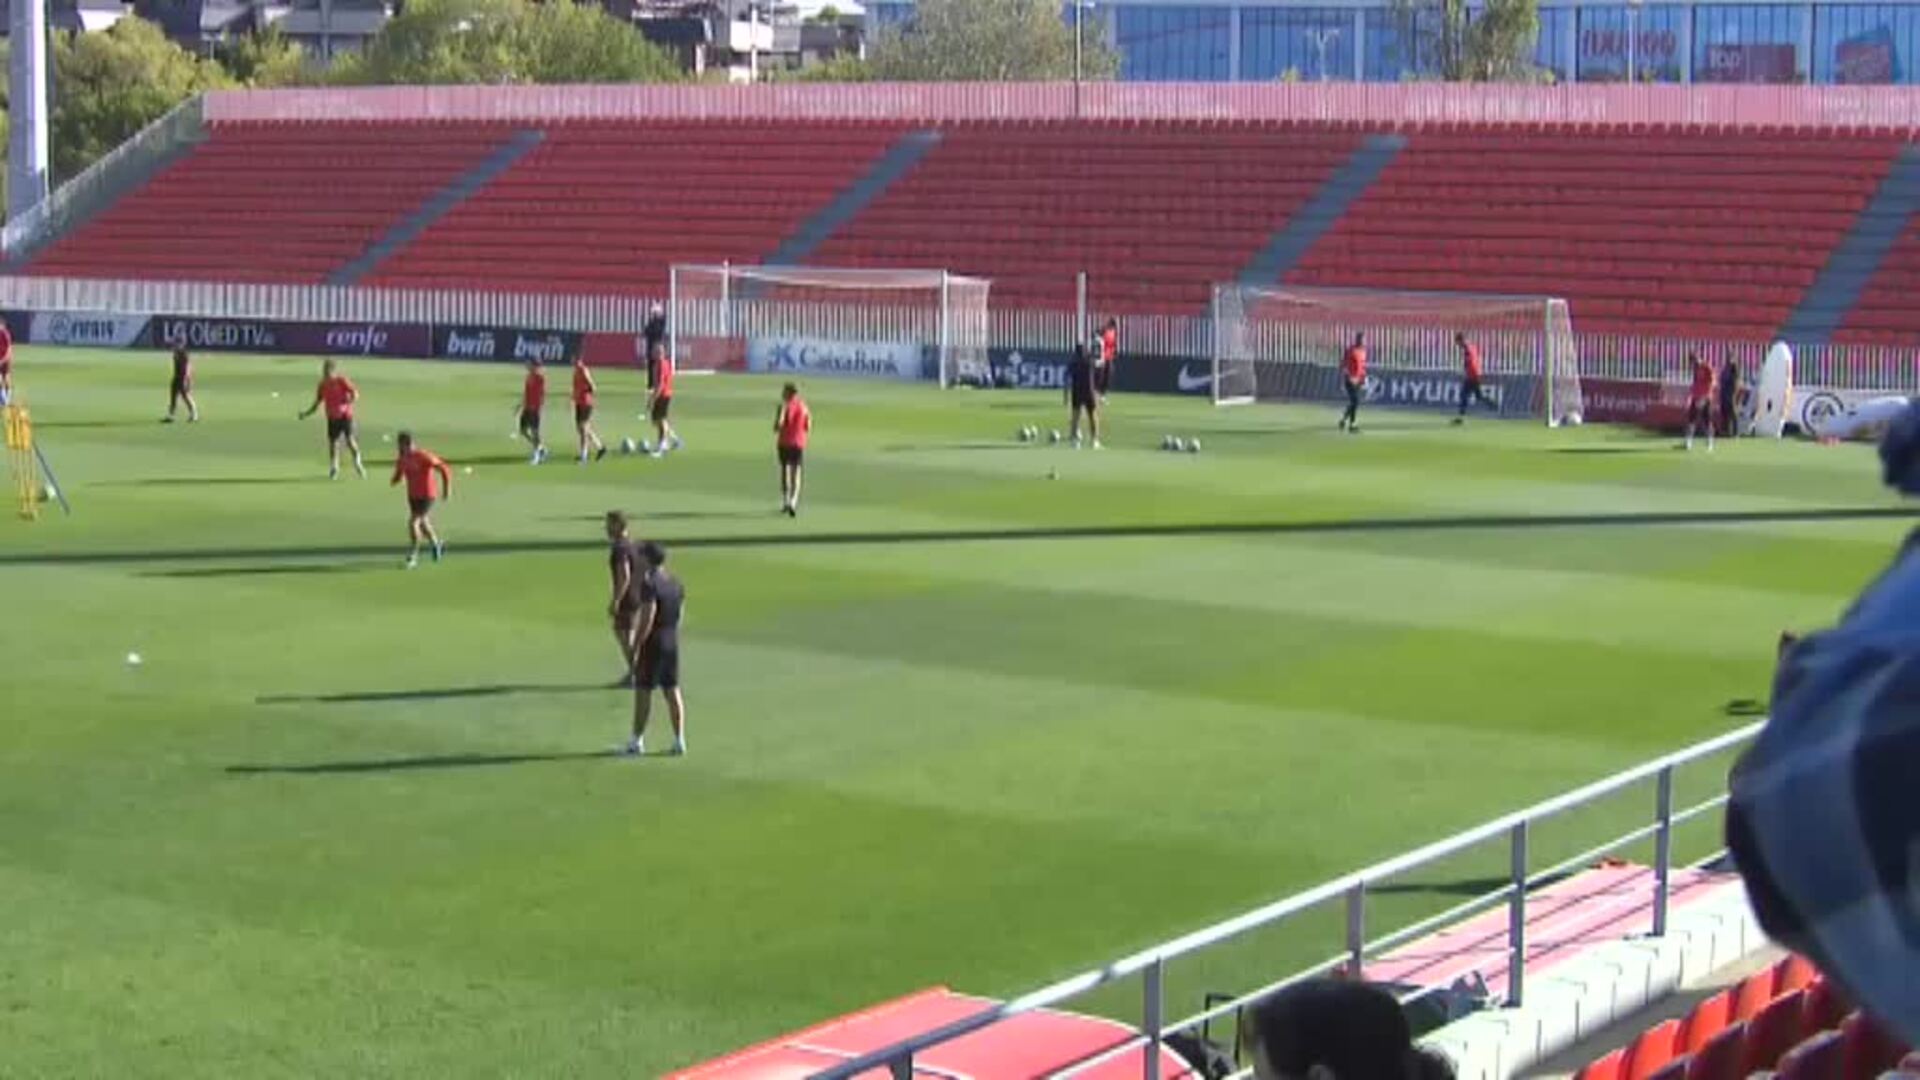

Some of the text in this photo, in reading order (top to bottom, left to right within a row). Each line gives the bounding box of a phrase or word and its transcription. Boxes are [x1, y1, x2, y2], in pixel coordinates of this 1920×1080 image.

[163, 320, 188, 347] LG
[242, 325, 264, 346] TV
[326, 325, 387, 355] renfe
[448, 331, 564, 361] bwin bwin
[800, 346, 899, 376] CaixaBank
[1391, 377, 1503, 406] HYUNAI
